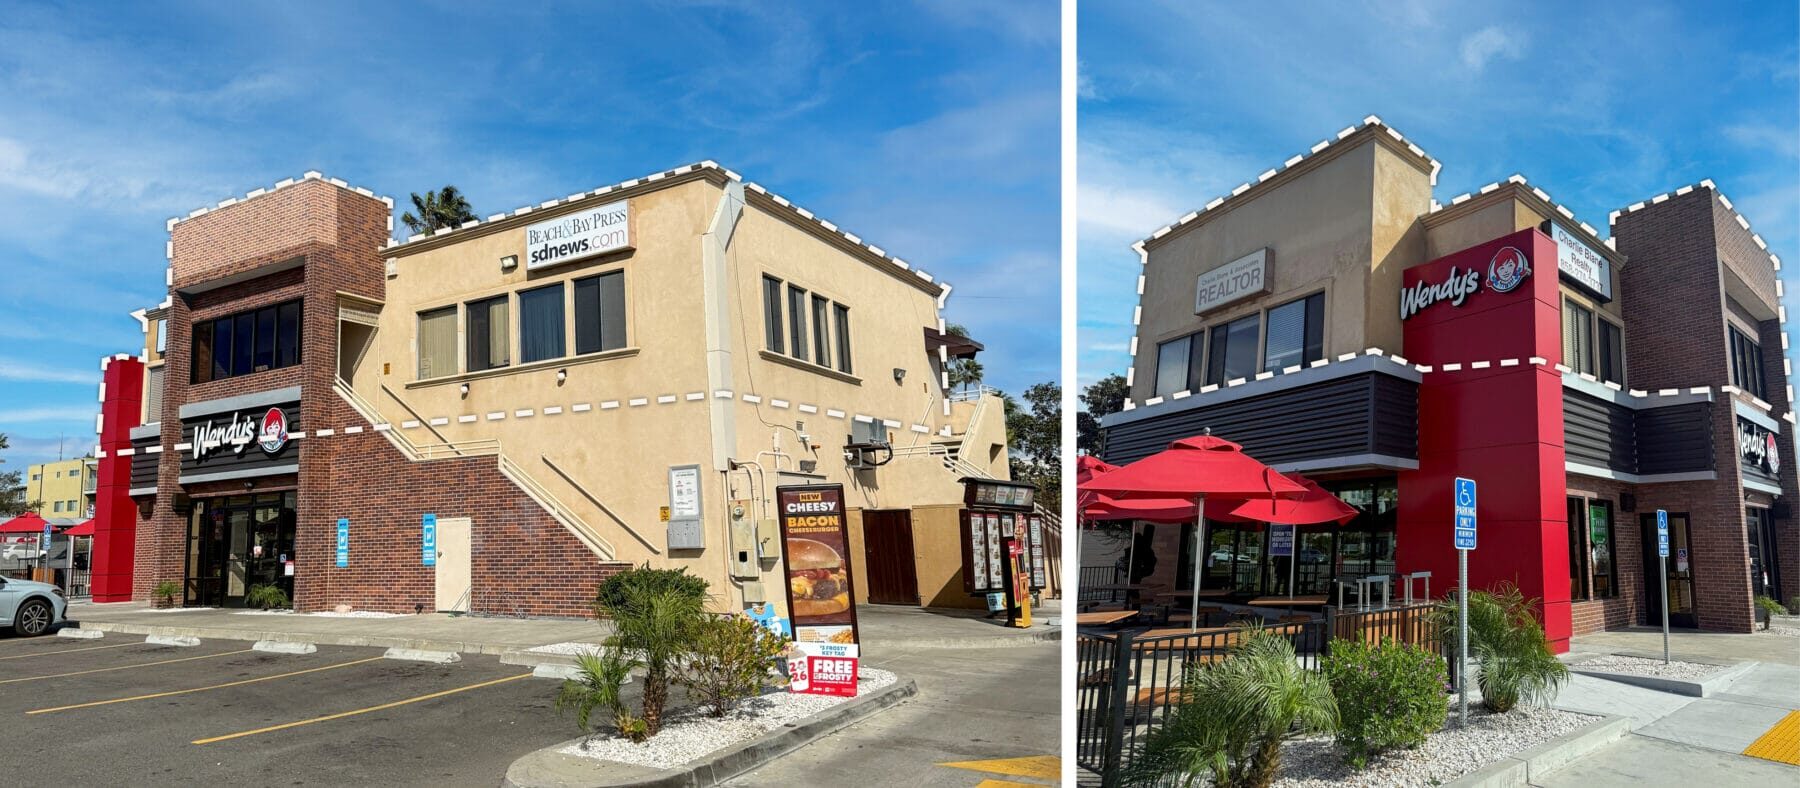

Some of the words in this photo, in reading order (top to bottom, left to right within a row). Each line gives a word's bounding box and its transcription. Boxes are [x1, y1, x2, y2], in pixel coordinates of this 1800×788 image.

[593, 209, 627, 229] PRESS
[531, 229, 625, 263] sdnews.com
[1559, 230, 1583, 255] Charlie
[1584, 247, 1603, 269] Blane
[1571, 252, 1592, 279] Realty
[1199, 267, 1261, 306] REALTOR
[1400, 265, 1479, 320] Wendy's
[193, 411, 256, 460] Wendy's
[787, 502, 836, 512] CHEESY
[787, 516, 839, 527] BACON
[813, 660, 853, 673] FREE
[819, 673, 852, 681] FROSTY
